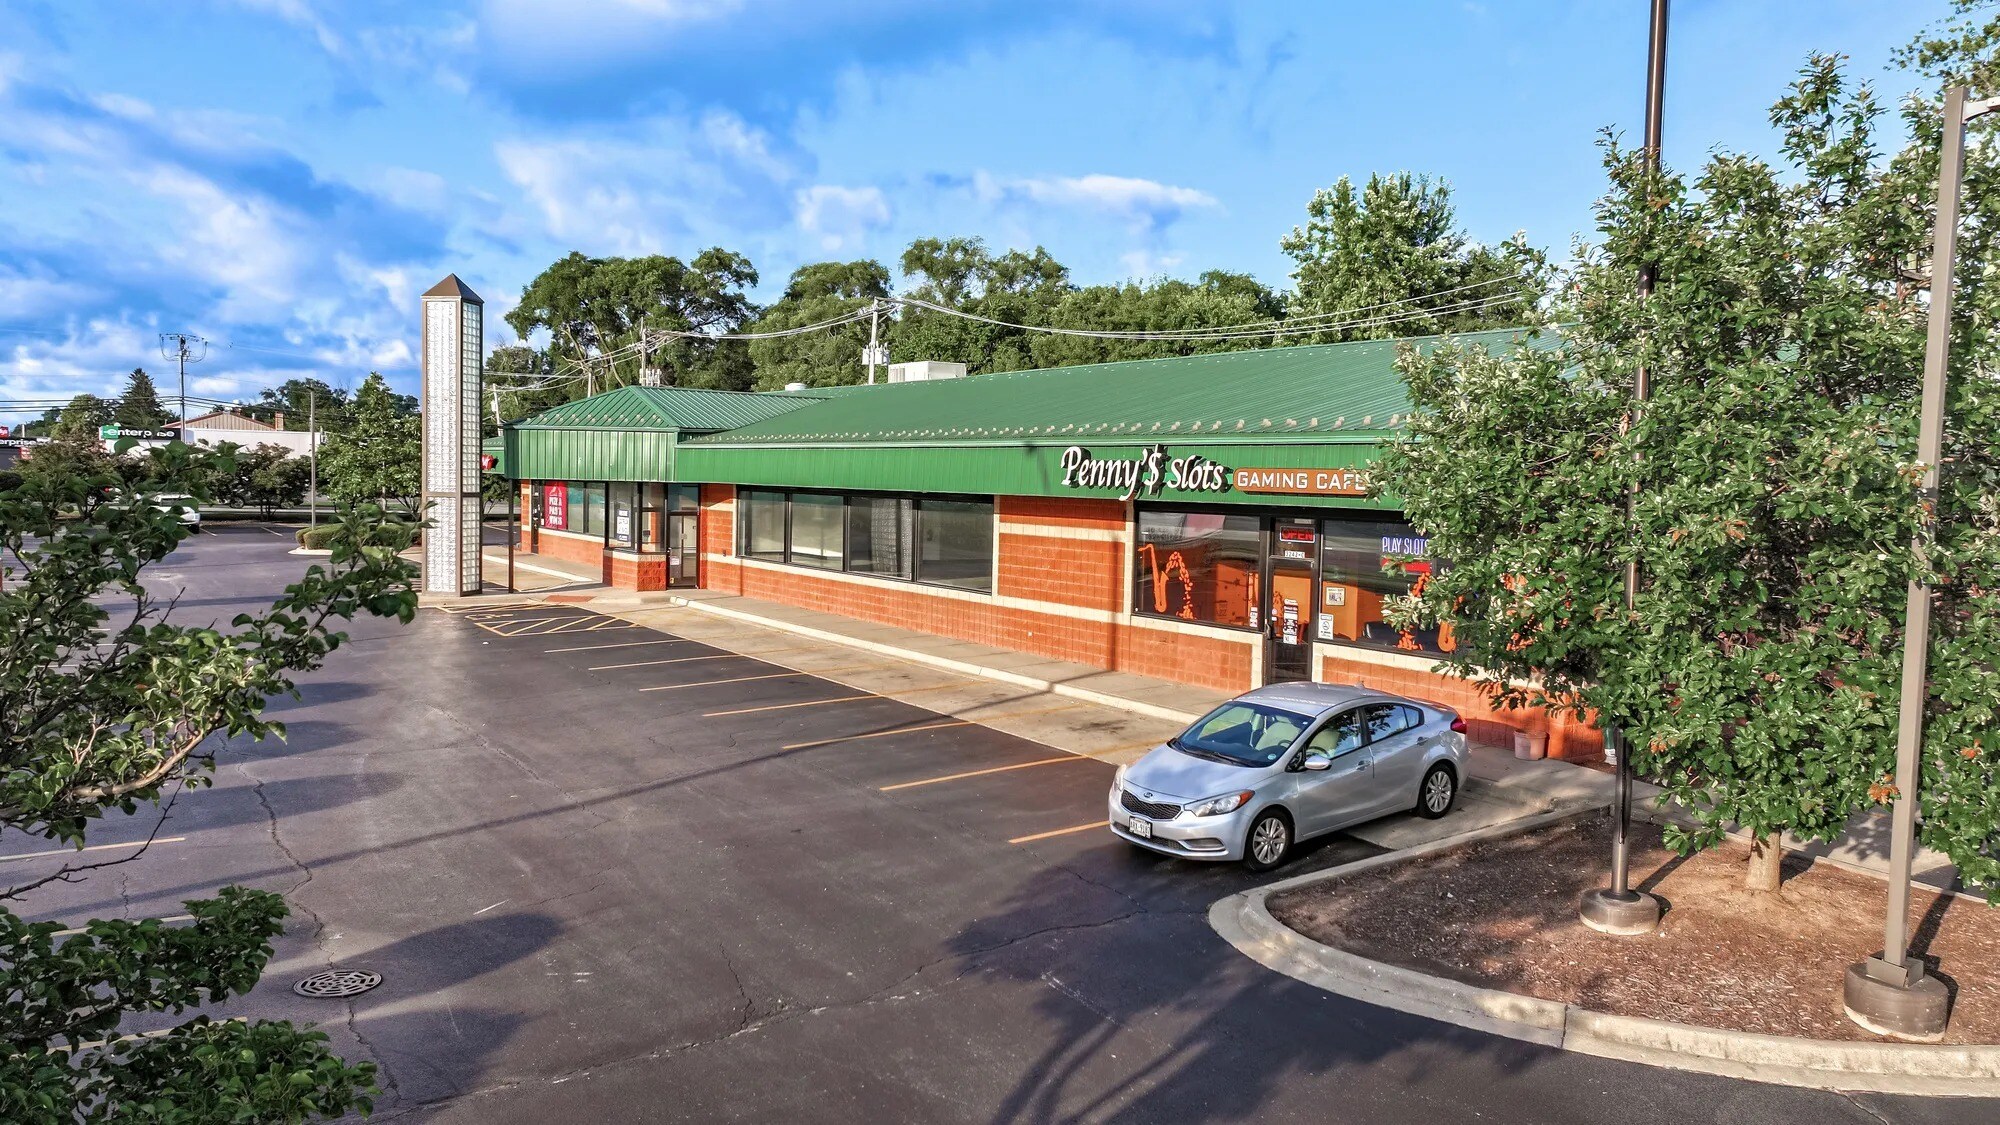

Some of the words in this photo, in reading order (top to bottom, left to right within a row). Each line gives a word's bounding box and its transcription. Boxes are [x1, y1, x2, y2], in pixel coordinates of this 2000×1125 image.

[104, 428, 175, 438] enterpise
[1167, 455, 1224, 490] Slots
[1237, 471, 1308, 489] GAMING
[1282, 529, 1314, 541] OPEN
[1382, 536, 1402, 553] PLAY
